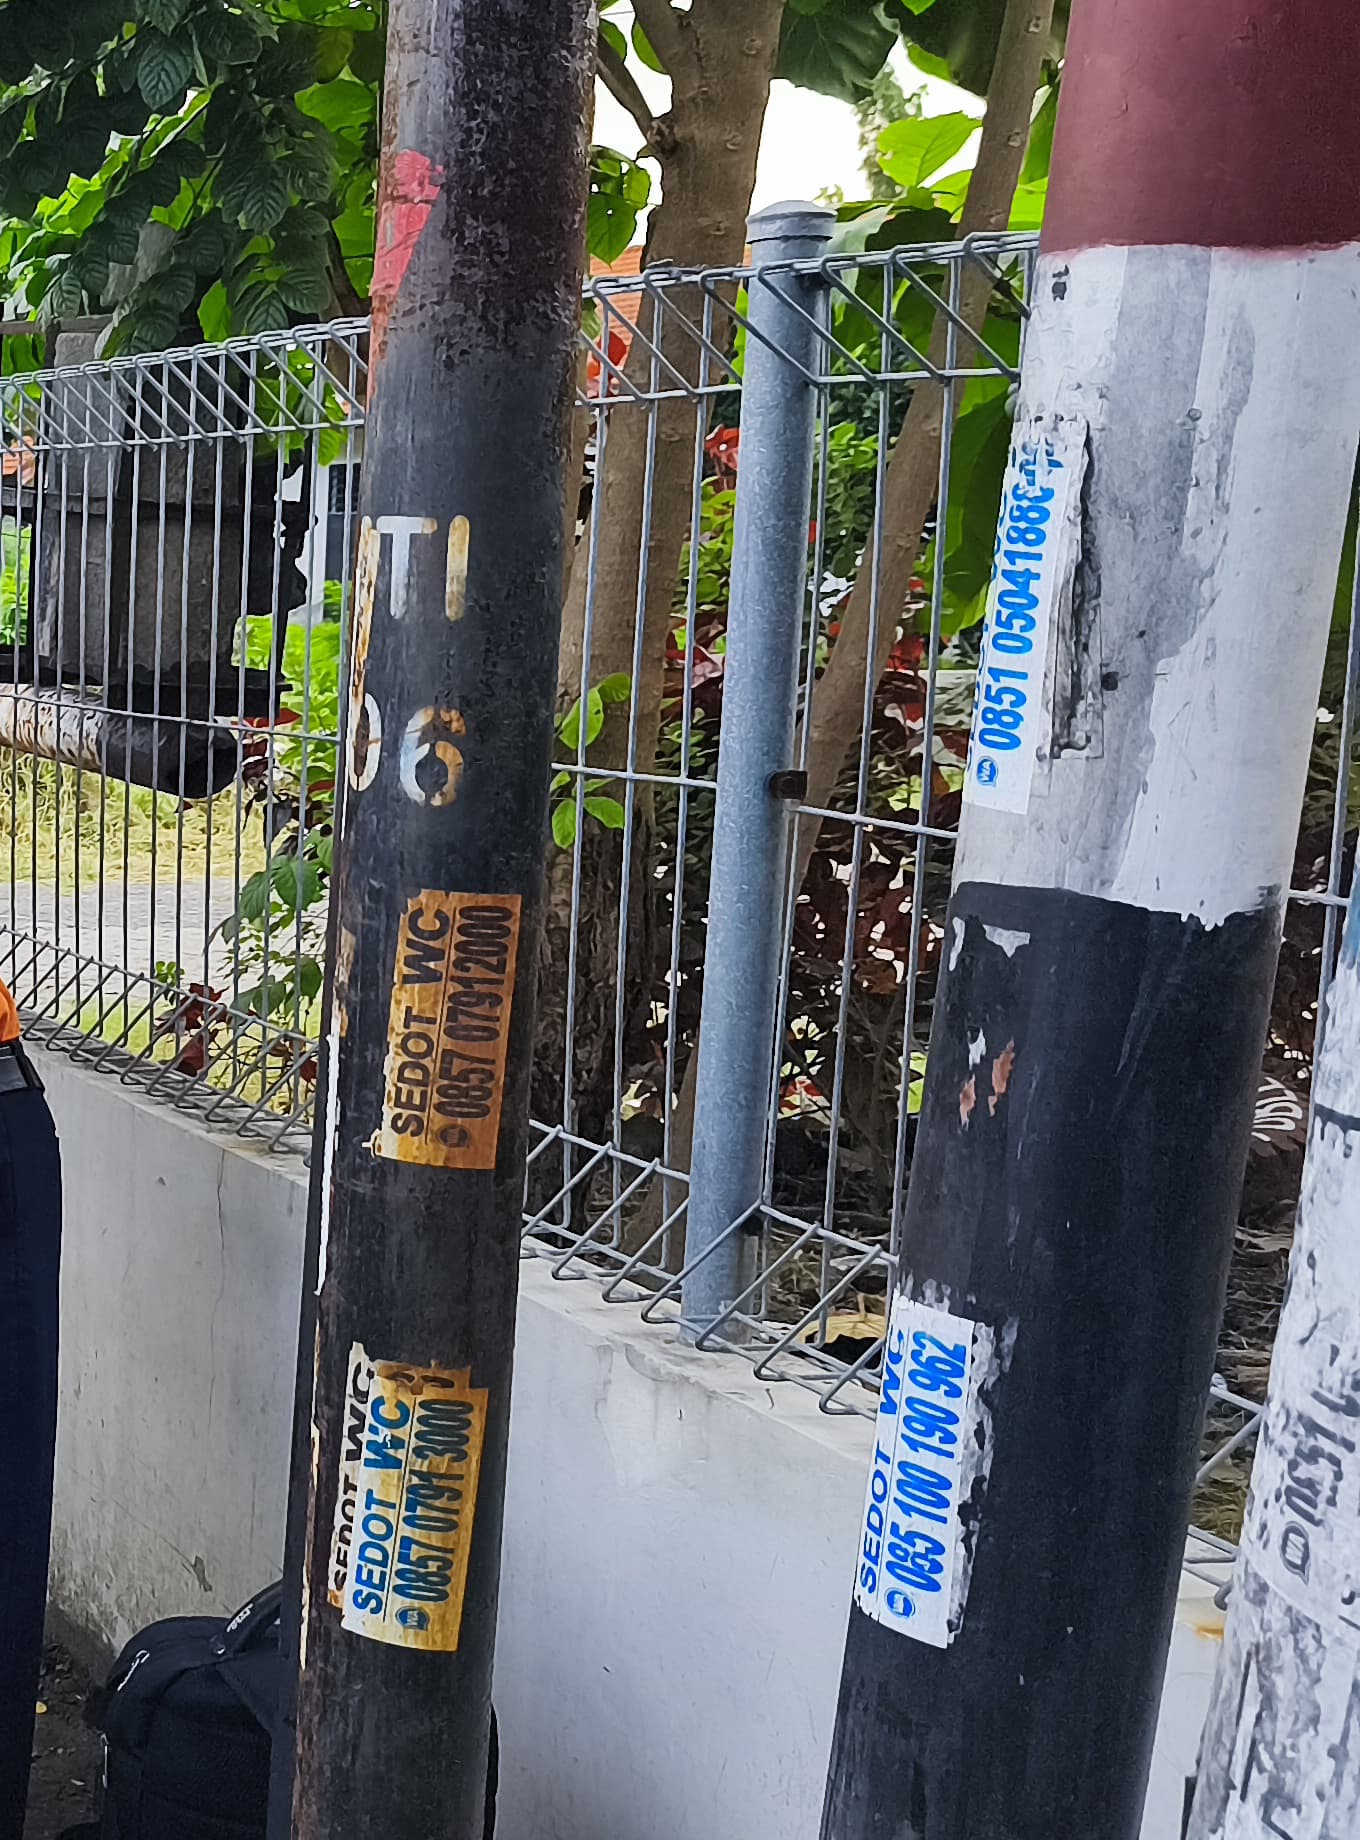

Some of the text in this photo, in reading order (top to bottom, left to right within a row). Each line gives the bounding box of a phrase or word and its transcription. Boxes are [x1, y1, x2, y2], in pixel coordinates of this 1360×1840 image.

[980, 666, 1029, 751] 0851
[390, 907, 450, 1138] SEDOT WC
[432, 1048, 497, 1120] 0857
[353, 1395, 411, 1616] SEDOT WC
[392, 1535, 456, 1602] 0857
[861, 1329, 905, 1594] SEDOT WC
[885, 1330, 967, 1593] 085 100 190 962
